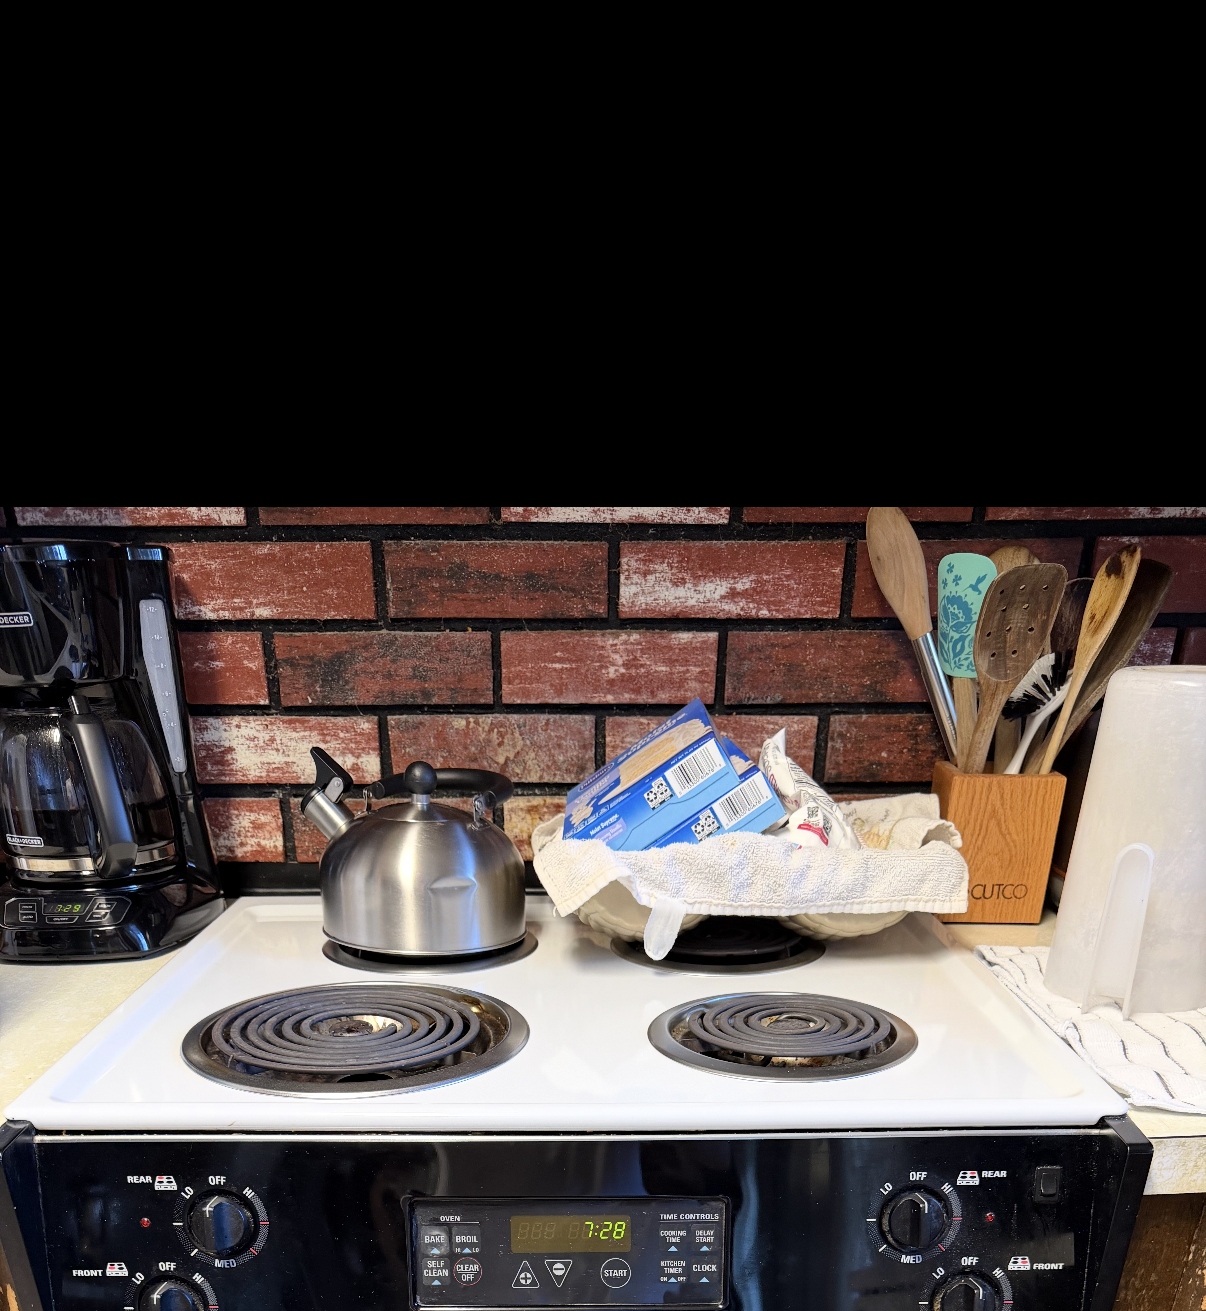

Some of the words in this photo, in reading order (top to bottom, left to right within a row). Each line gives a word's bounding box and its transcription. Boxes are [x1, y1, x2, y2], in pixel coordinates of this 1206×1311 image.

[970, 883, 1029, 900] CUTCO
[57, 904, 82, 913] 7:29
[909, 1171, 928, 1181] OFF
[981, 1170, 1007, 1178] REAR
[126, 1175, 153, 1184] REAR
[208, 1175, 227, 1186] OFF
[180, 1186, 194, 1200] LO
[242, 1186, 256, 1199] HI
[879, 1182, 893, 1196] LO
[940, 1182, 954, 1194] HI
[584, 1221, 626, 1240] 7:28
[424, 1235, 446, 1244] BAKE
[455, 1235, 479, 1243] BROIL
[214, 1258, 237, 1268] MED
[900, 1254, 923, 1264] MED
[961, 1256, 979, 1266] OFF
[158, 1261, 177, 1272] OFF
[426, 1260, 445, 1269] SELF
[456, 1263, 481, 1272] CLEAR
[692, 1264, 717, 1272] CLOCK
[1032, 1262, 1064, 1270] FRONT
[72, 1269, 103, 1277] FRONT
[423, 1268, 449, 1277] CLEAN
[461, 1273, 475, 1282] OFF
[603, 1269, 628, 1279] START
[931, 1266, 945, 1280] LO
[992, 1267, 1005, 1279] HI
[131, 1272, 145, 1285] LO
[192, 1272, 205, 1284] HI
